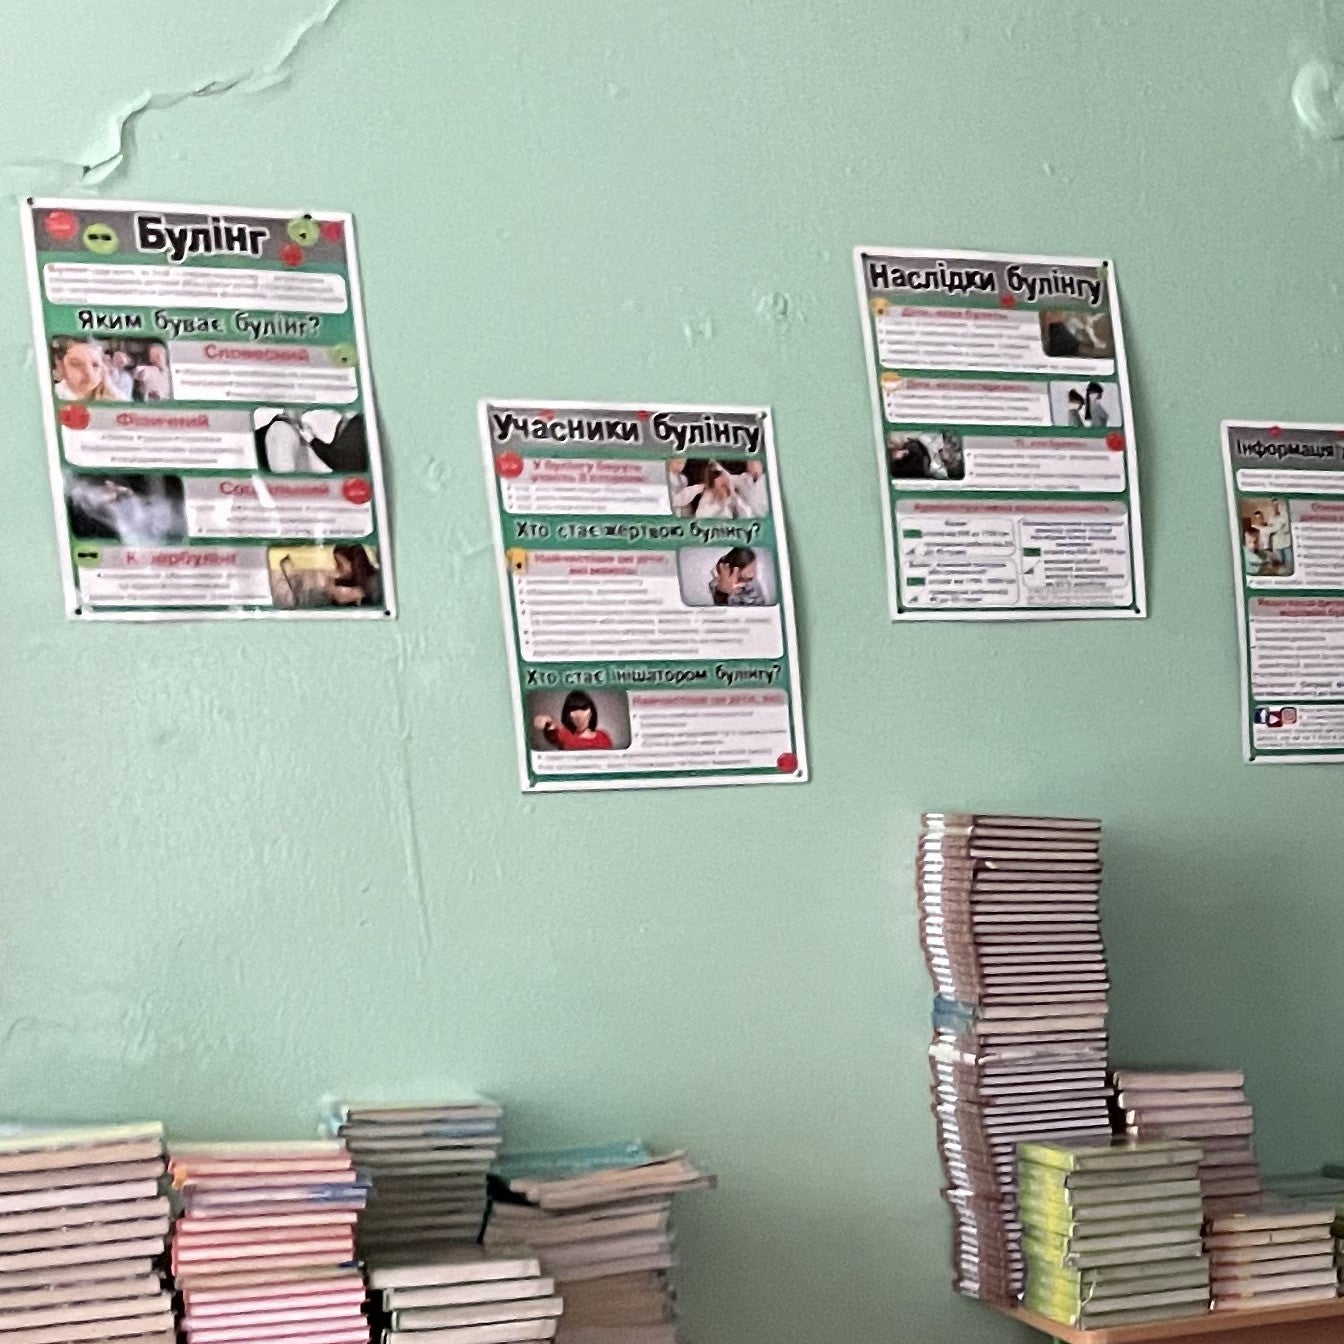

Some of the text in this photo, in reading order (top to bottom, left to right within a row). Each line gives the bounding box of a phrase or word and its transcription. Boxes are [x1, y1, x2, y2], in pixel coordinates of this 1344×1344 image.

[138, 215, 269, 261] Булінг
[870, 263, 1102, 302] Наслідки булінгу
[78, 310, 320, 339] Яким буває булінг?
[493, 412, 760, 453] Учасники булінгу
[516, 521, 549, 538] Хто
[557, 524, 600, 538] стає
[526, 669, 557, 685] Хто
